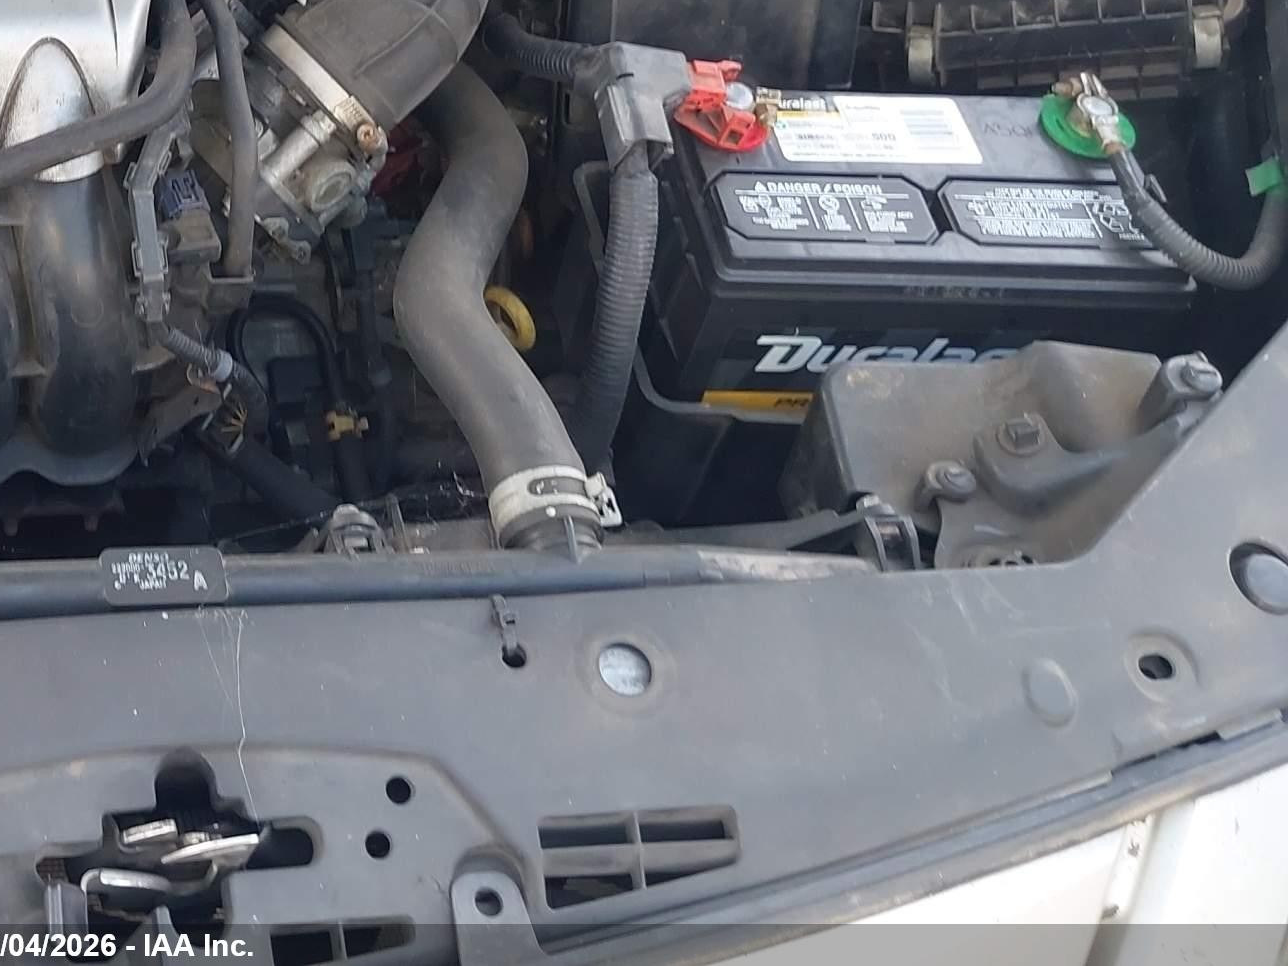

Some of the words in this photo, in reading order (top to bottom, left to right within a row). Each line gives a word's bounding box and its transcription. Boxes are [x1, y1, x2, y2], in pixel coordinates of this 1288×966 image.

[778, 97, 826, 110] uralast
[767, 181, 821, 194] DANGER
[834, 183, 883, 195] POISON
[193, 569, 208, 591] A
